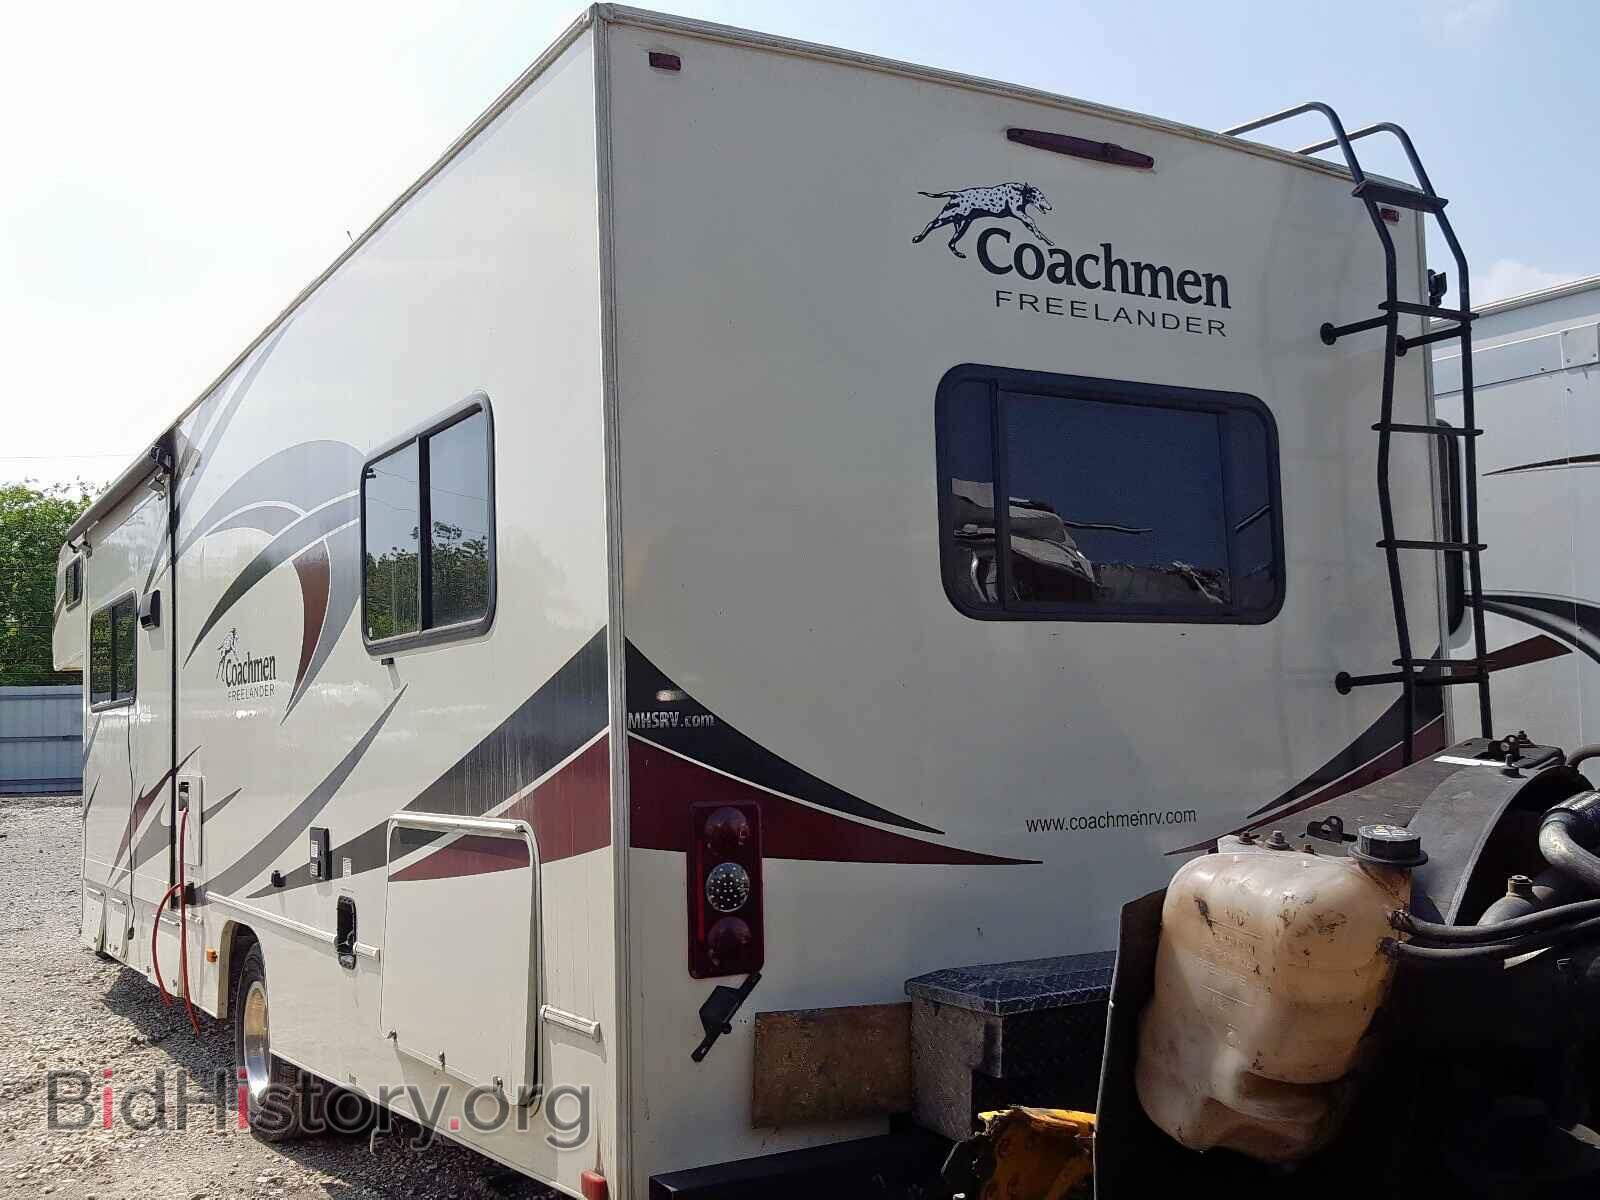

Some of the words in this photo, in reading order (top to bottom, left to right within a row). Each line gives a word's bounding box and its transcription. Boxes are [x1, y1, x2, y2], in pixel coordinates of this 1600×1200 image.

[976, 227, 1232, 309] Coachmen
[995, 289, 1228, 337] FREELANDER
[225, 651, 276, 688] Coachmen
[228, 683, 275, 701] FREELANDER
[1025, 808, 1197, 833] www.coachmenrv.com
